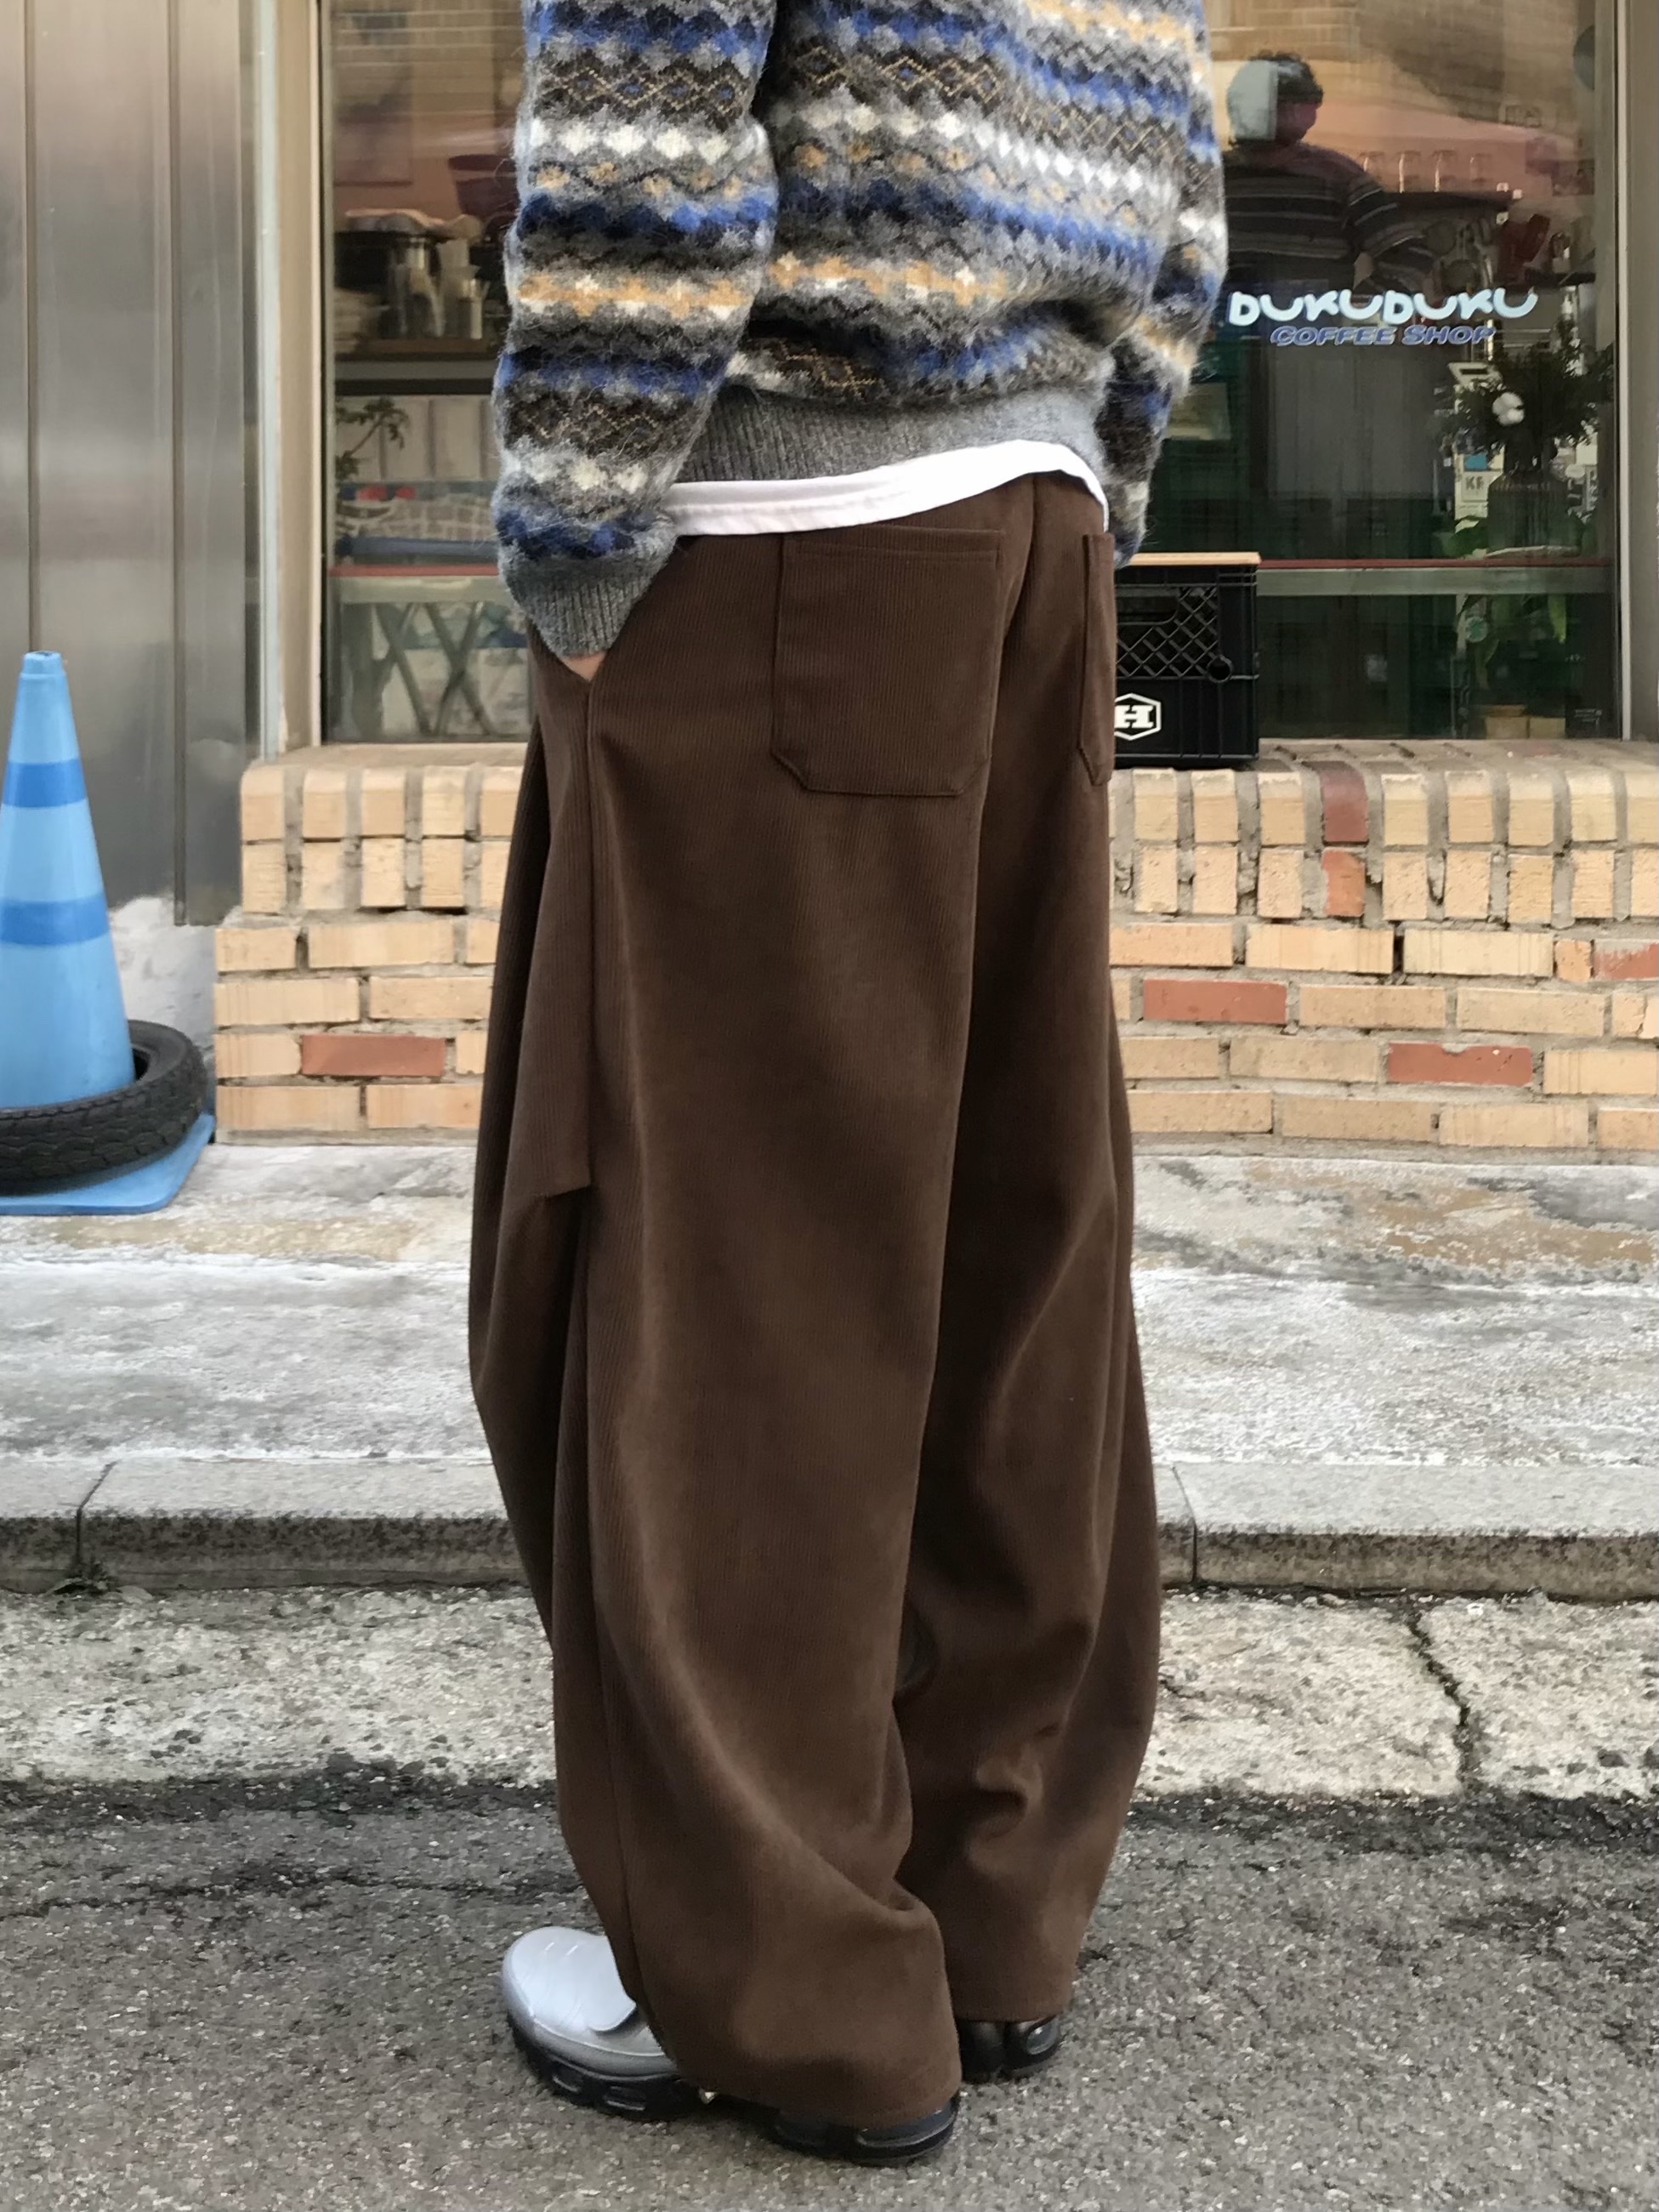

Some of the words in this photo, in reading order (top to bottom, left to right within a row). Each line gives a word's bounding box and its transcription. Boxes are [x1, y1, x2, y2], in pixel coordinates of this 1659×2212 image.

[1230, 287, 1538, 326] DUKUDUKU
[1270, 325, 1395, 346] COFFEE
[1401, 324, 1497, 345] SHOP
